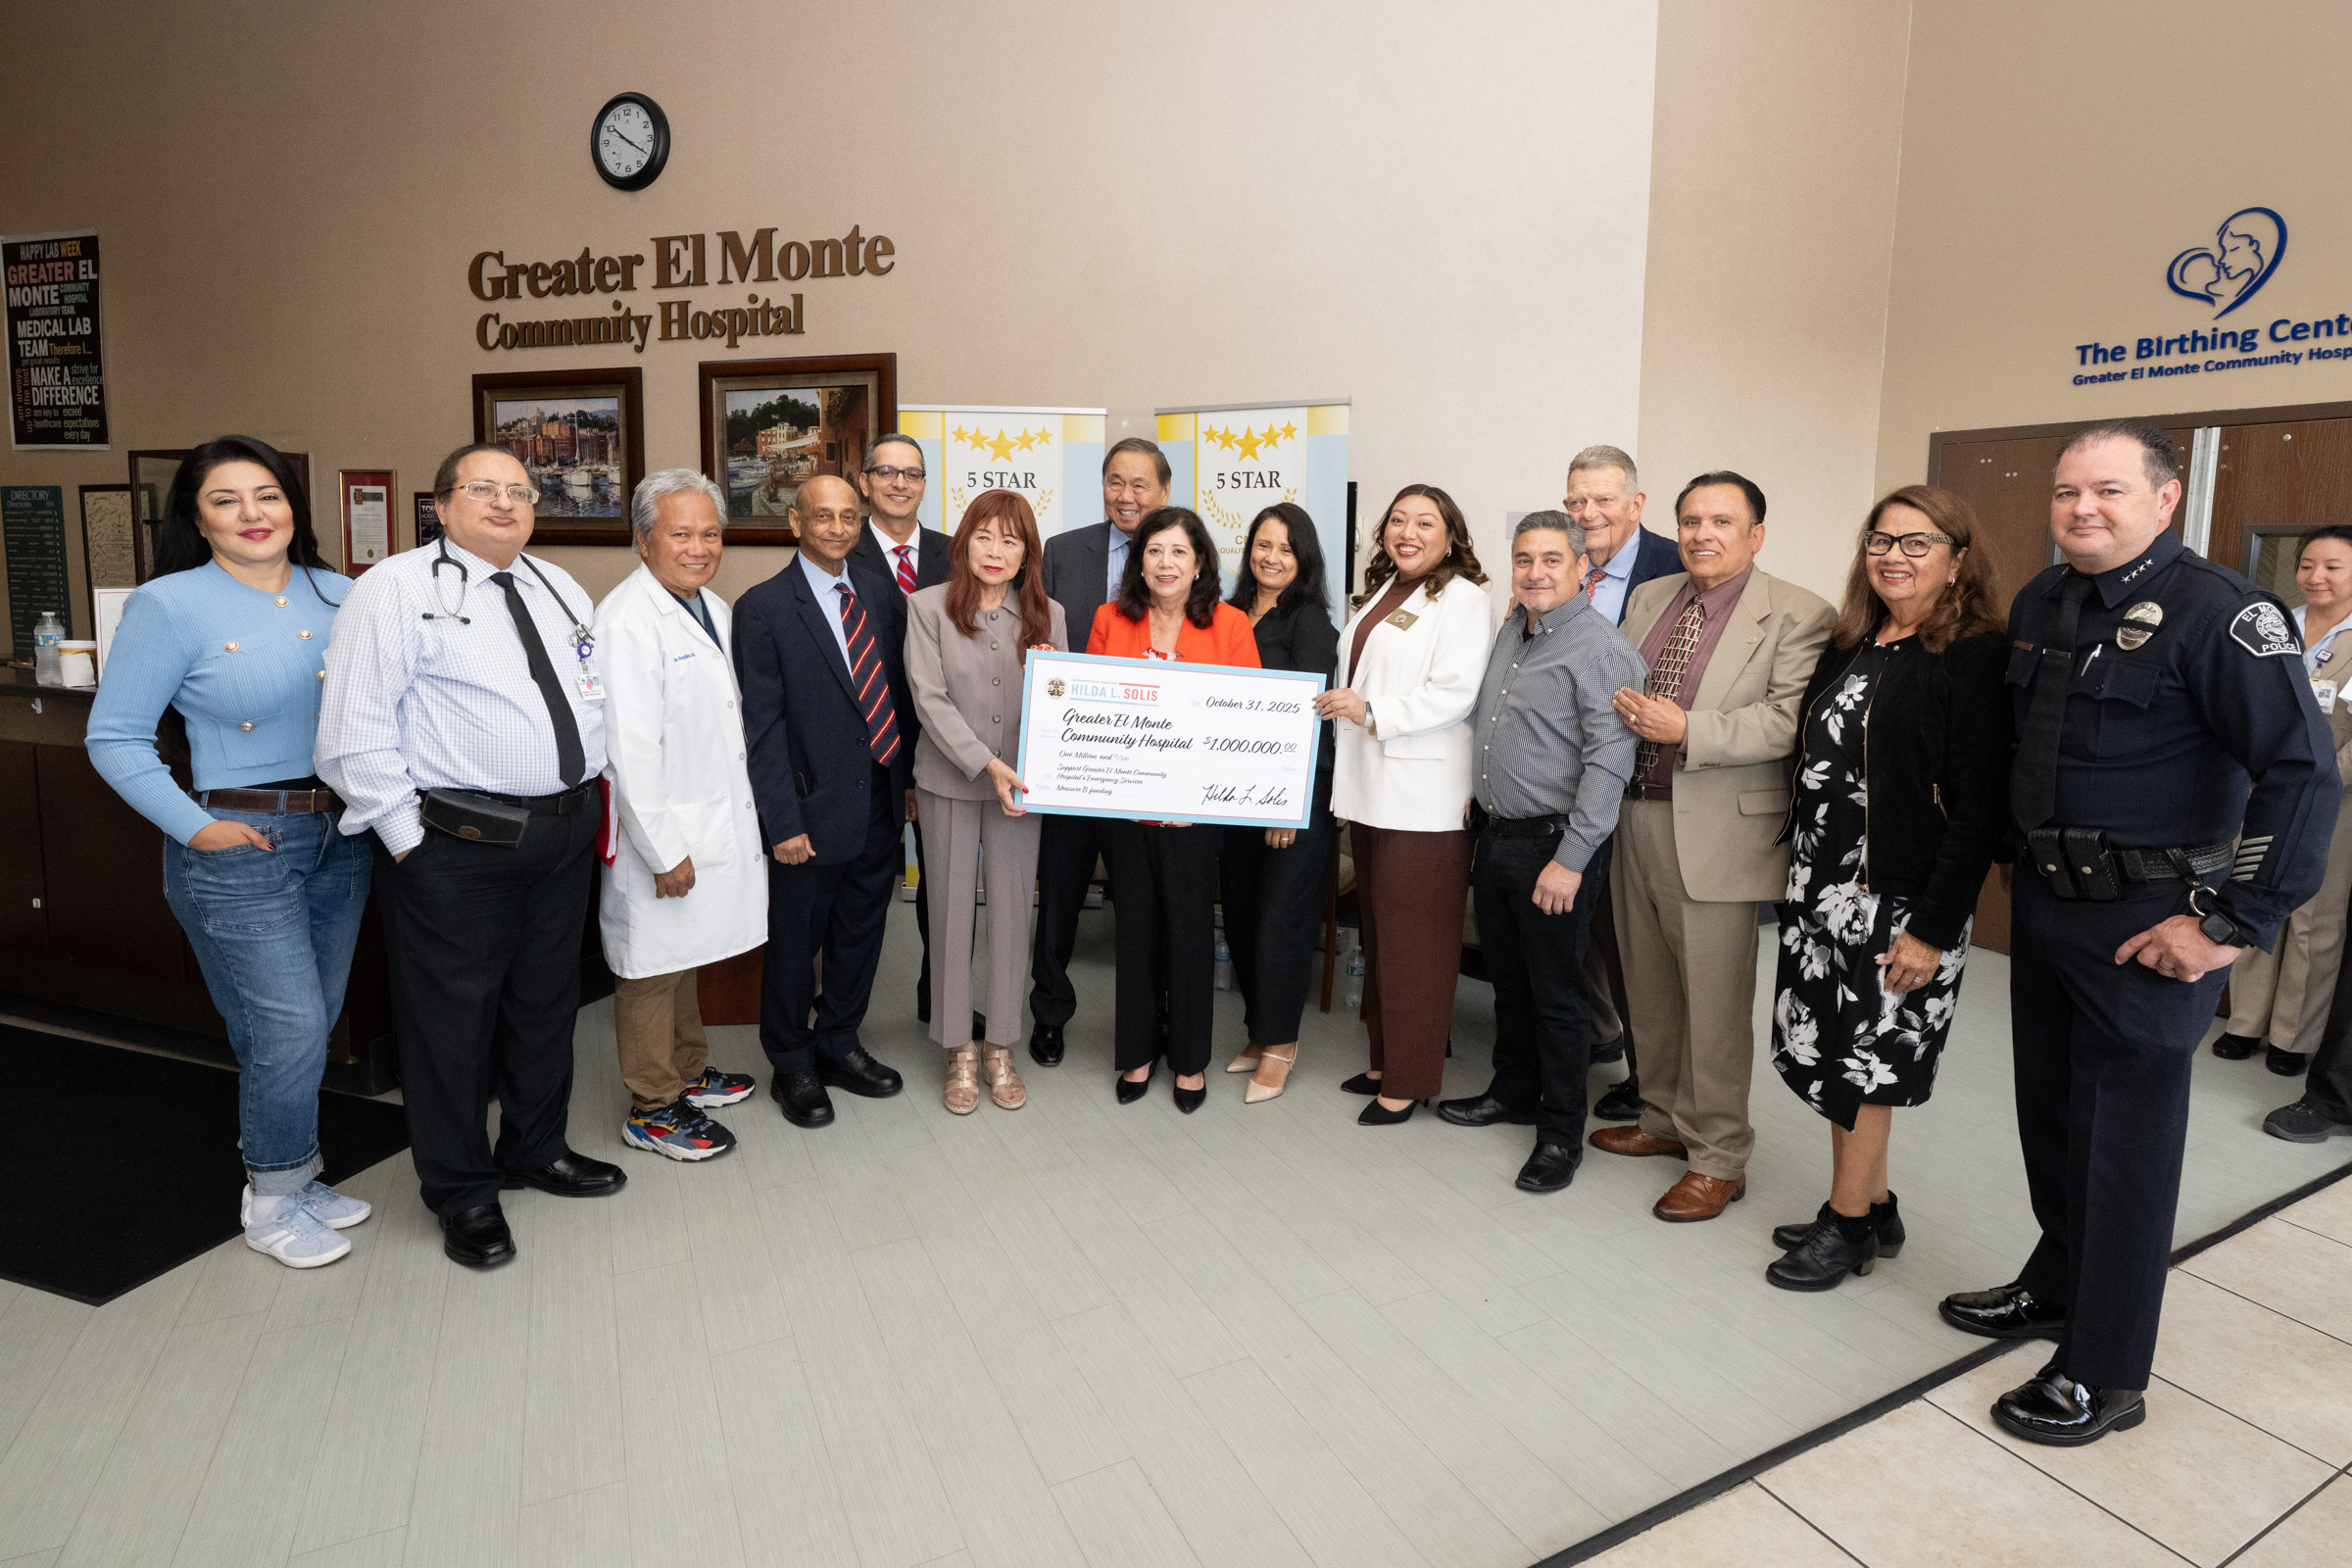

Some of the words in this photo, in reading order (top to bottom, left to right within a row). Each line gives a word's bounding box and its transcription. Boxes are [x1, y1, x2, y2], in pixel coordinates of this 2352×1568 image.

[20, 243, 44, 261] HAPPY
[45, 242, 59, 259] LAB
[60, 240, 81, 257] WEEK
[468, 247, 644, 302] Greater
[650, 233, 707, 290] El
[716, 224, 896, 284] Monte
[8, 261, 74, 285] GREATER
[78, 260, 98, 280] EL
[9, 284, 59, 307] MONTE
[60, 282, 89, 293] COMMUNITY
[65, 294, 88, 304] HOSPITAL
[29, 306, 60, 317] LABORATORY
[17, 318, 66, 338] MEDICAL
[69, 317, 91, 336] LAB
[476, 300, 652, 353] Community
[658, 294, 806, 348] Hospital
[18, 339, 49, 357] TEAM
[49, 343, 80, 355] Therefore
[2076, 343, 2127, 366] The
[2135, 327, 2260, 360] Birthing
[2269, 314, 2352, 343] Cent
[71, 364, 88, 374] strive
[89, 363, 98, 374] for
[2073, 370, 2127, 385] Greater
[2131, 368, 2144, 379] El
[2148, 363, 2200, 378] Monte
[2204, 349, 2303, 371] Community
[30, 367, 61, 386] MAKE
[63, 366, 72, 385] A
[72, 374, 103, 385] excellence
[31, 385, 99, 406] DIFFERENCE
[18, 406, 24, 421] am
[24, 408, 31, 417] to
[63, 406, 81, 416] exceed
[26, 420, 33, 433] up
[63, 417, 99, 430] expectations
[64, 431, 78, 442] every
[80, 429, 90, 442] day
[966, 471, 977, 489] 5
[982, 470, 1037, 489] STAR
[1217, 472, 1225, 489] 5
[1231, 470, 1281, 489] STAR
[11, 490, 49, 500] DIRECTORY
[2241, 612, 2258, 622] EL
[2262, 643, 2297, 652] POLICE
[1071, 684, 1106, 698] HILDA
[1111, 687, 1120, 699] L.
[1123, 688, 1157, 702] SOLIS
[1205, 696, 1243, 709] October
[1267, 702, 1301, 713] 2025
[1062, 708, 1112, 726] Greater
[1113, 713, 1130, 727] El
[1131, 716, 1173, 730] Monte
[1061, 727, 1138, 749] Community
[1138, 734, 1193, 753] Hospital
[1056, 763, 1081, 773] Support
[1133, 769, 1167, 778] Community
[1086, 775, 1119, 785] Emergency
[1088, 787, 1112, 796] funding
[1201, 784, 1238, 805] Hilda
[1255, 786, 1288, 805] Solis
